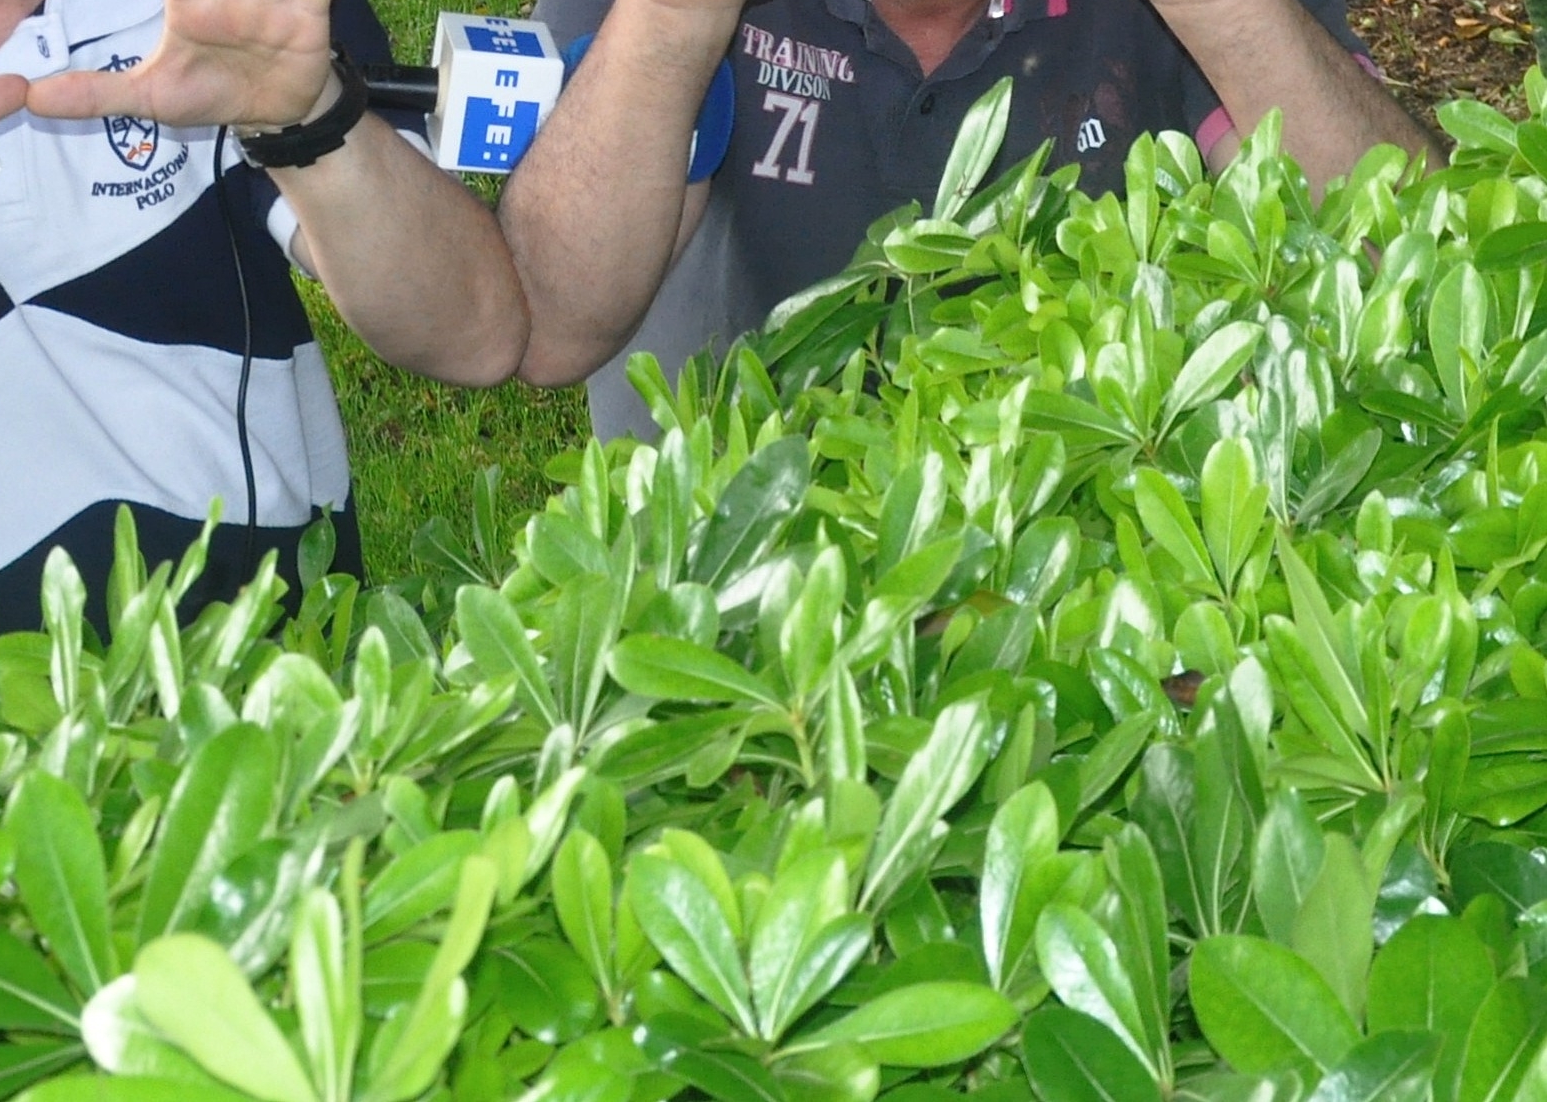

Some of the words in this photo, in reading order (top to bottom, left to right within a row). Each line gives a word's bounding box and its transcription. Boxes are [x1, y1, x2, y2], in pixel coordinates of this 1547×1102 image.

[757, 61, 831, 101] DIVISON
[752, 89, 821, 185] 71
[135, 183, 175, 210] POLO
